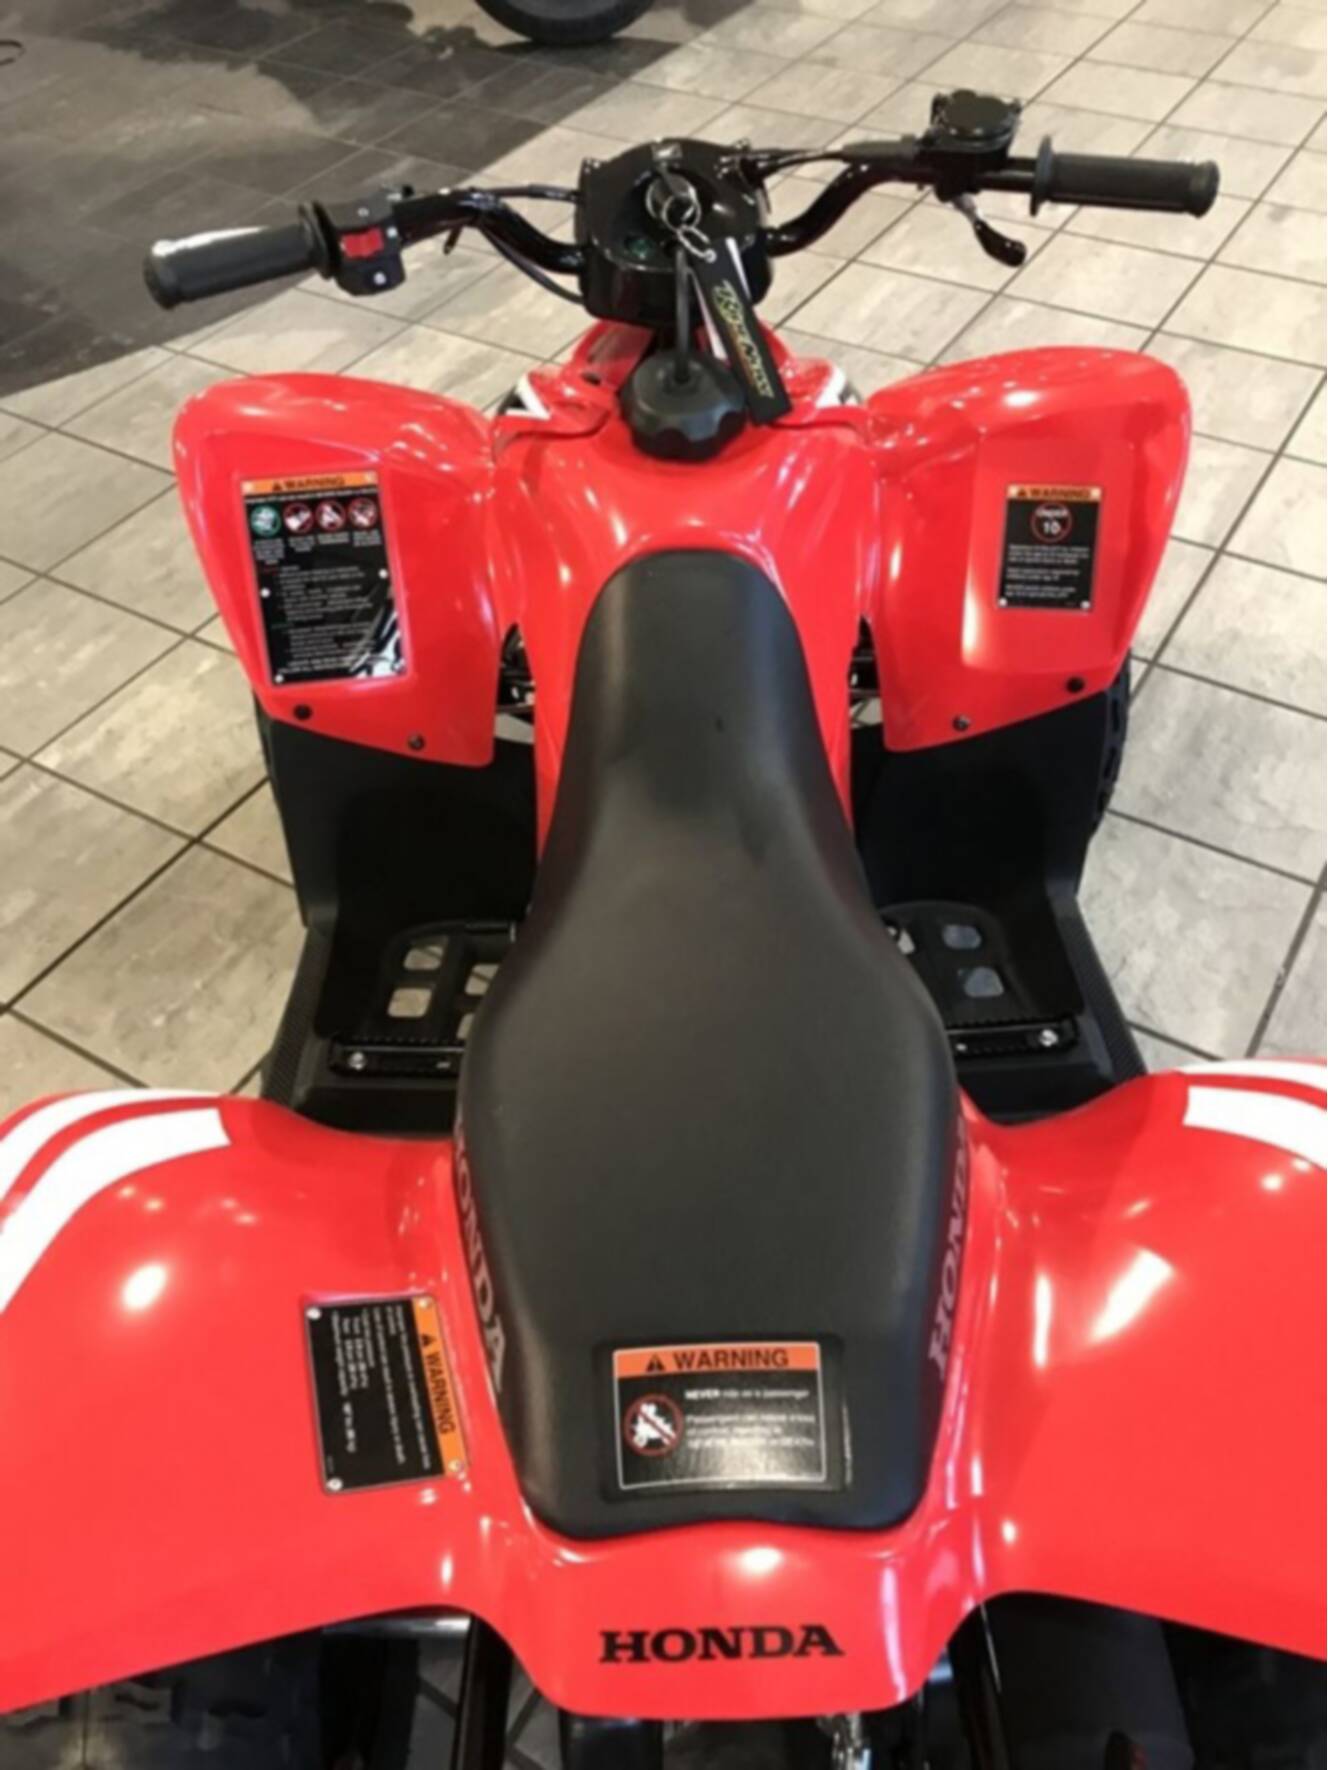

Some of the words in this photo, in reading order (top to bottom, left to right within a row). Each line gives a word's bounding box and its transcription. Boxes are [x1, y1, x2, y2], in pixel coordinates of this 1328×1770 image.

[673, 1349, 790, 1371] WARNING
[426, 1352, 457, 1435] WARNING
[598, 1623, 846, 1663] HONDA
